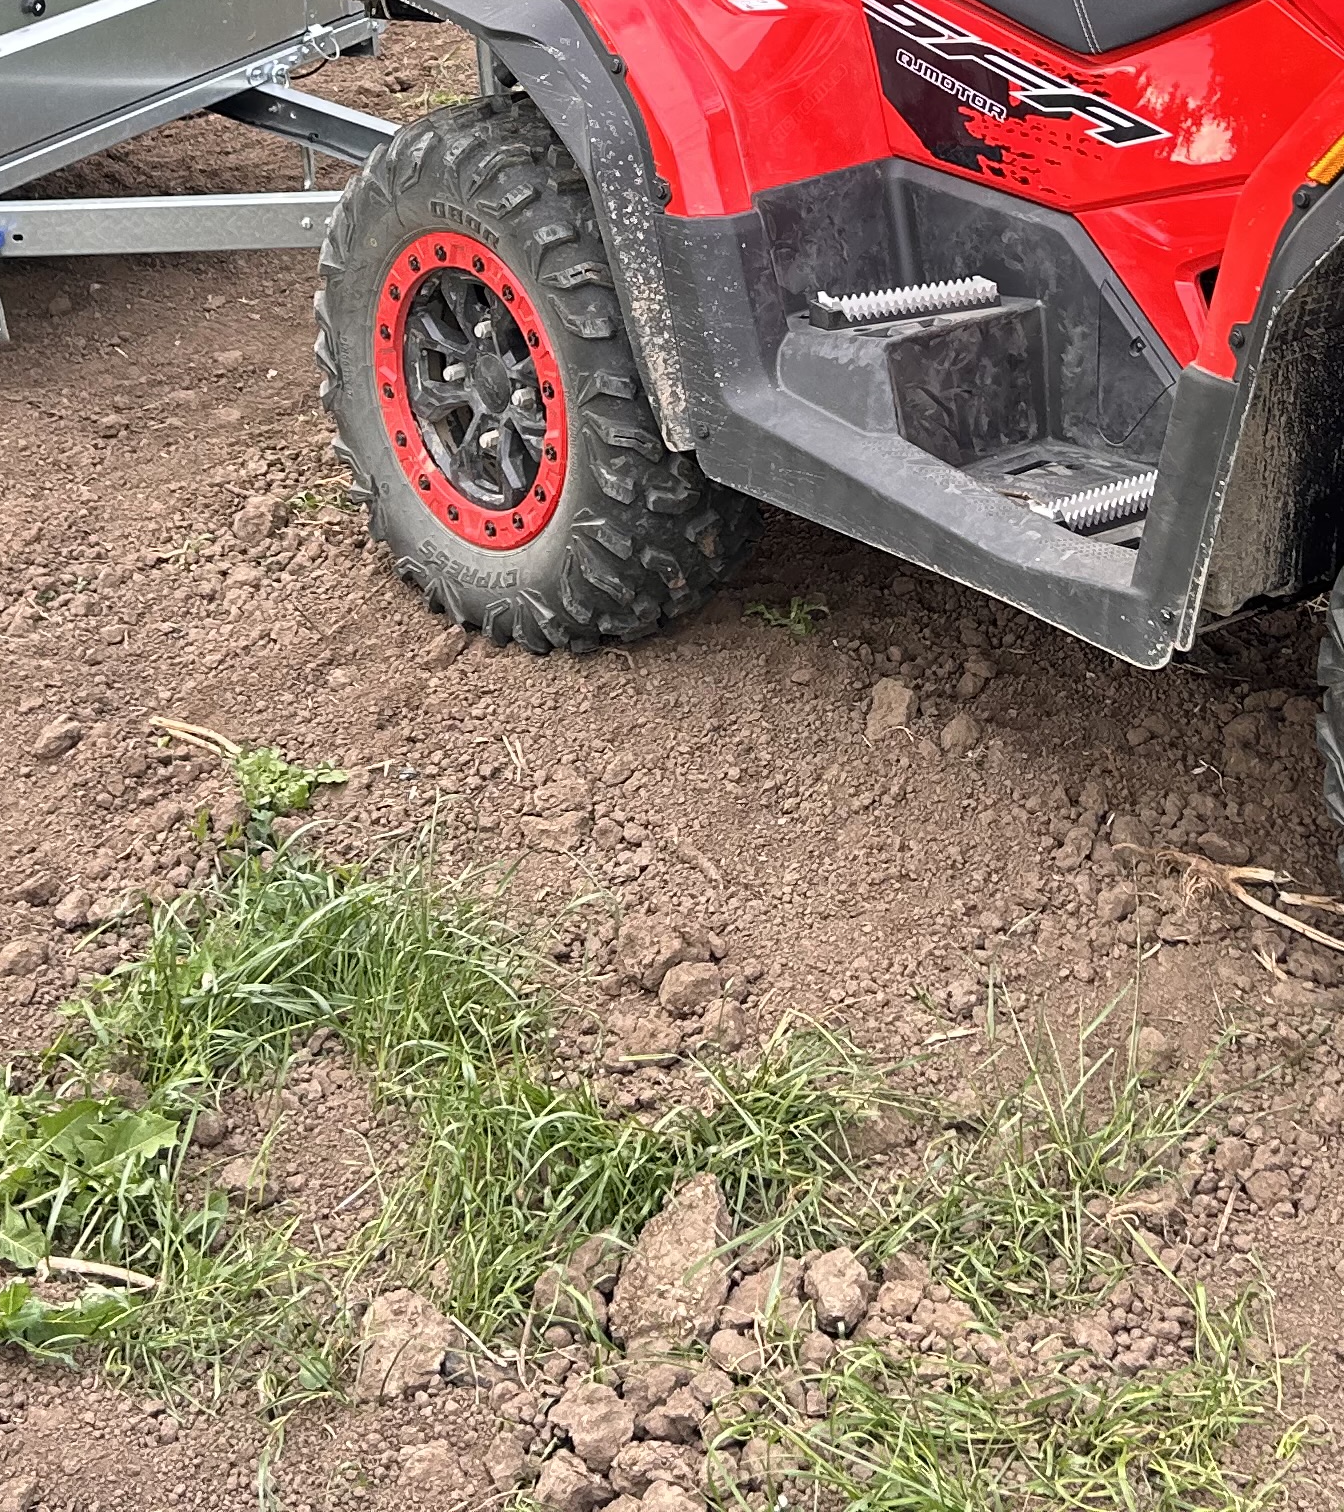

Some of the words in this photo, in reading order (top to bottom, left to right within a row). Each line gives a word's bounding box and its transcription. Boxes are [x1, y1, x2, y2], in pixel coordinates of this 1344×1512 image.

[896, 48, 1007, 121] QJMOTOR
[430, 199, 500, 246] OBOR
[419, 538, 519, 588] CYPRESS
